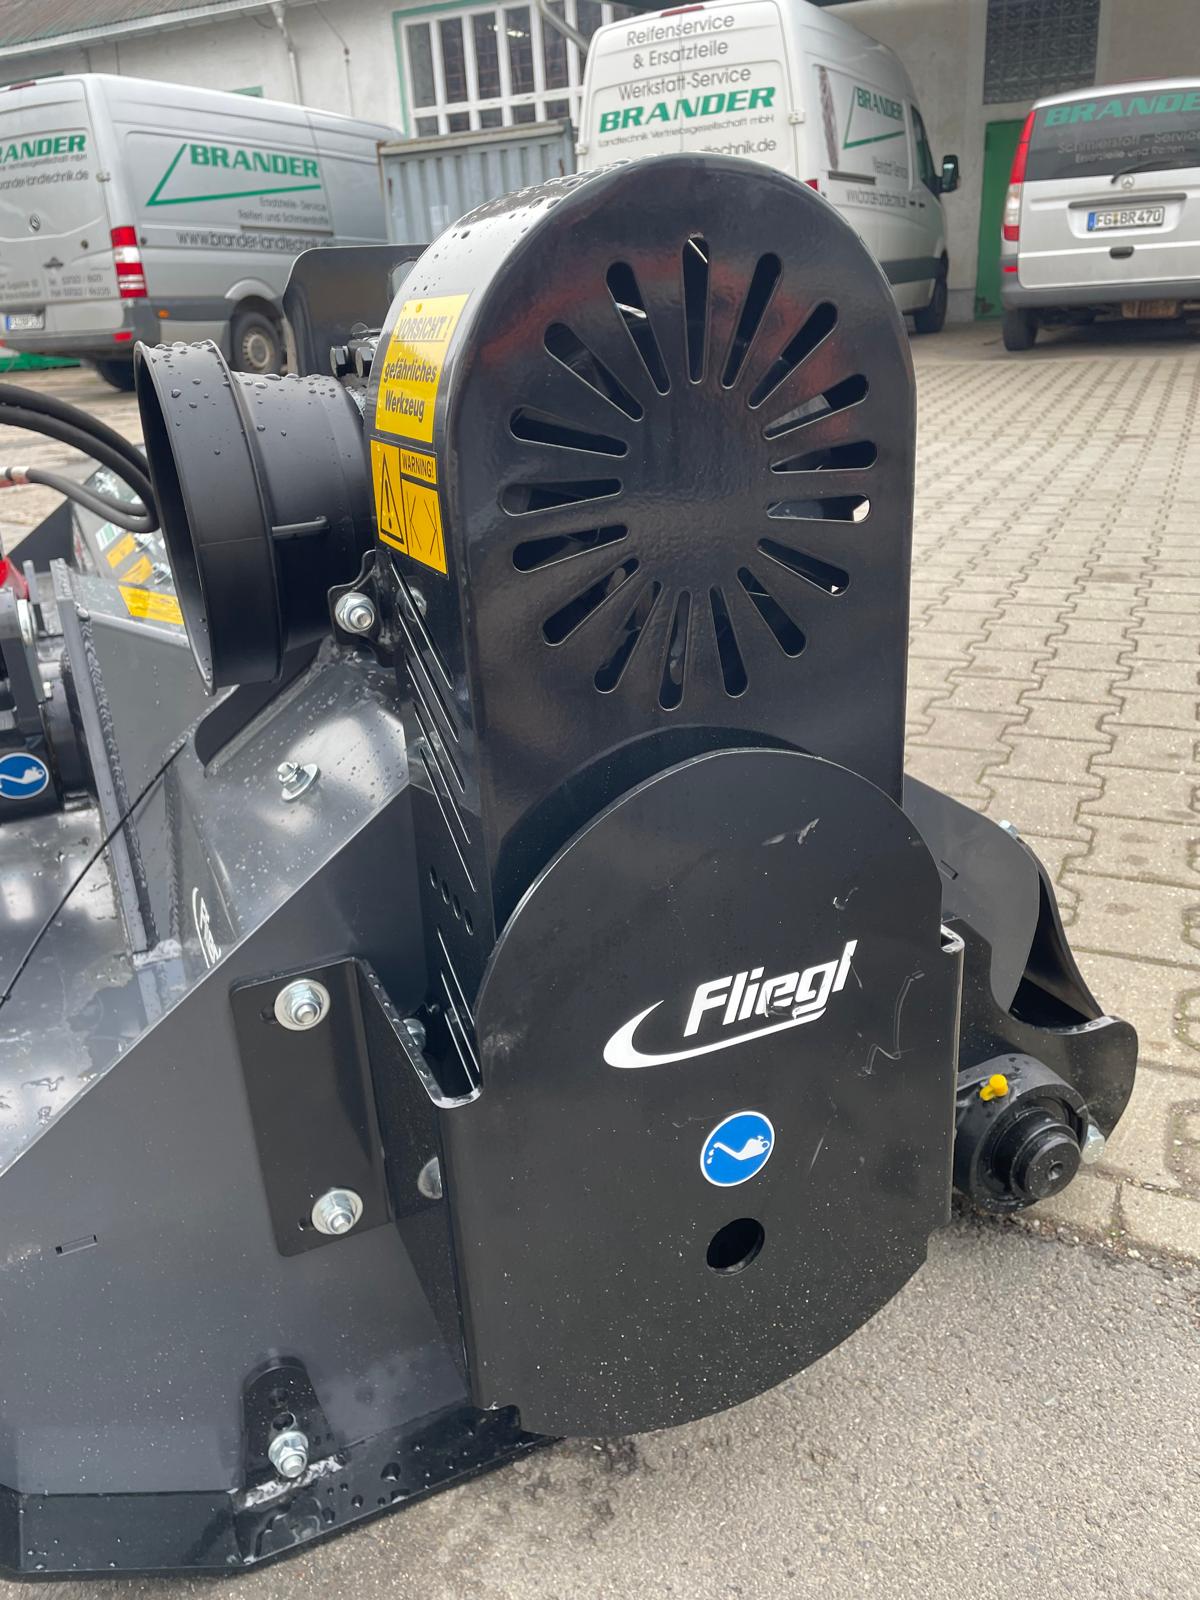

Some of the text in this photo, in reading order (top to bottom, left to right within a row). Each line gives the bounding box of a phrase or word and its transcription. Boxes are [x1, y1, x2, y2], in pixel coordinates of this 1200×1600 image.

[626, 15, 735, 46] Reifenservice
[633, 41, 729, 70] & Ersatzteile
[618, 68, 751, 101] Werkstatt-Service
[599, 87, 776, 133] BRANDER
[1044, 91, 1200, 127] BRANDE
[190, 144, 320, 178] BRANDER
[1096, 213, 1112, 226] FG
[397, 315, 447, 340] VORSICHT
[384, 358, 437, 385] gefährliches
[384, 388, 425, 423] Werkzeug
[401, 455, 434, 480] WARNING!
[683, 939, 858, 1037] Fliegl
